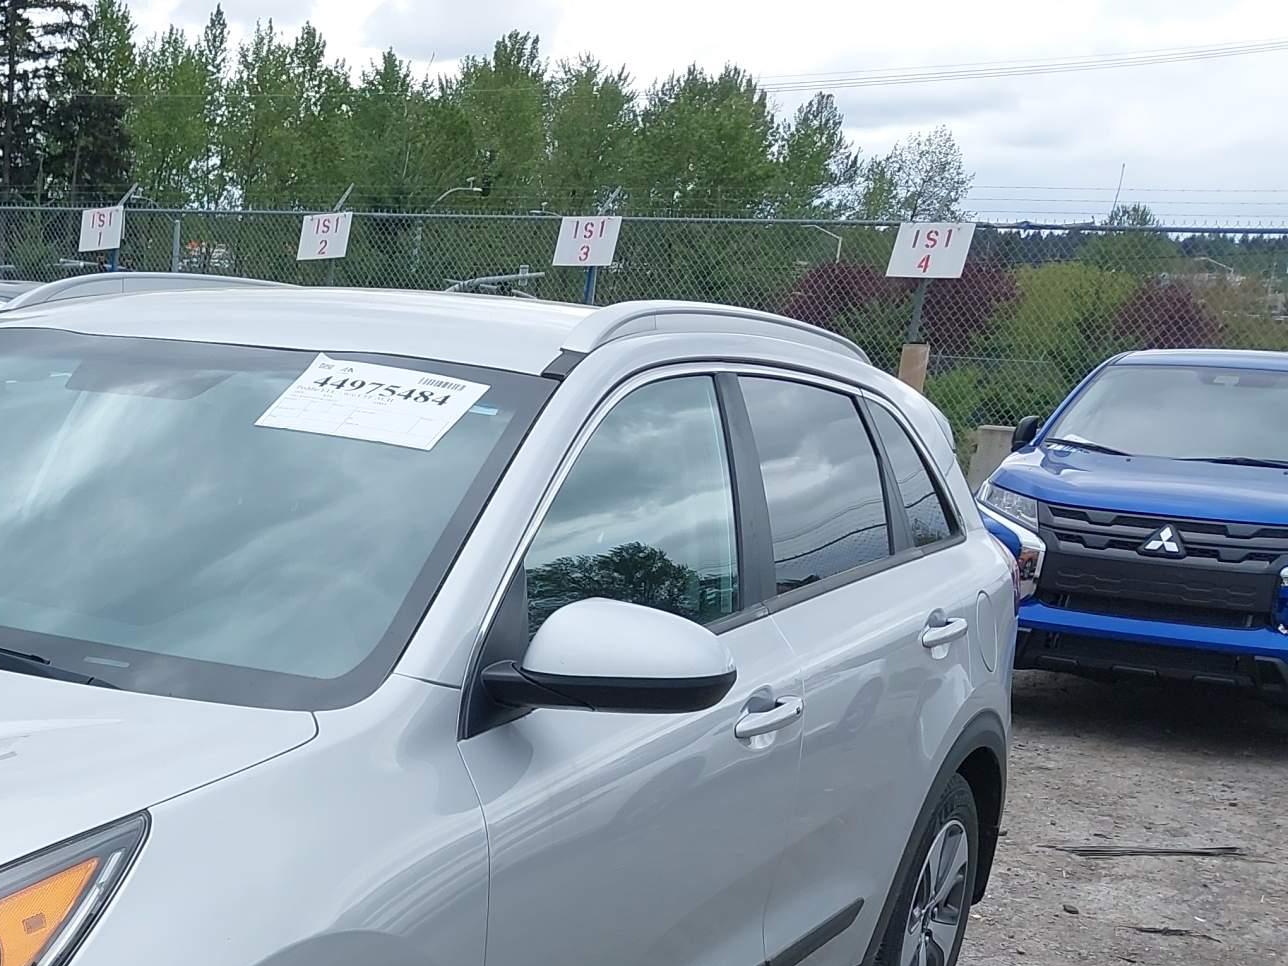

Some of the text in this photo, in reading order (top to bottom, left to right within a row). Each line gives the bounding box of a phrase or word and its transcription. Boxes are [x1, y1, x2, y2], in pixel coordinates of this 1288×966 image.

[318, 239, 328, 255] 2
[579, 245, 590, 262] 3
[917, 254, 931, 273] 4
[313, 375, 452, 406] 44975484
